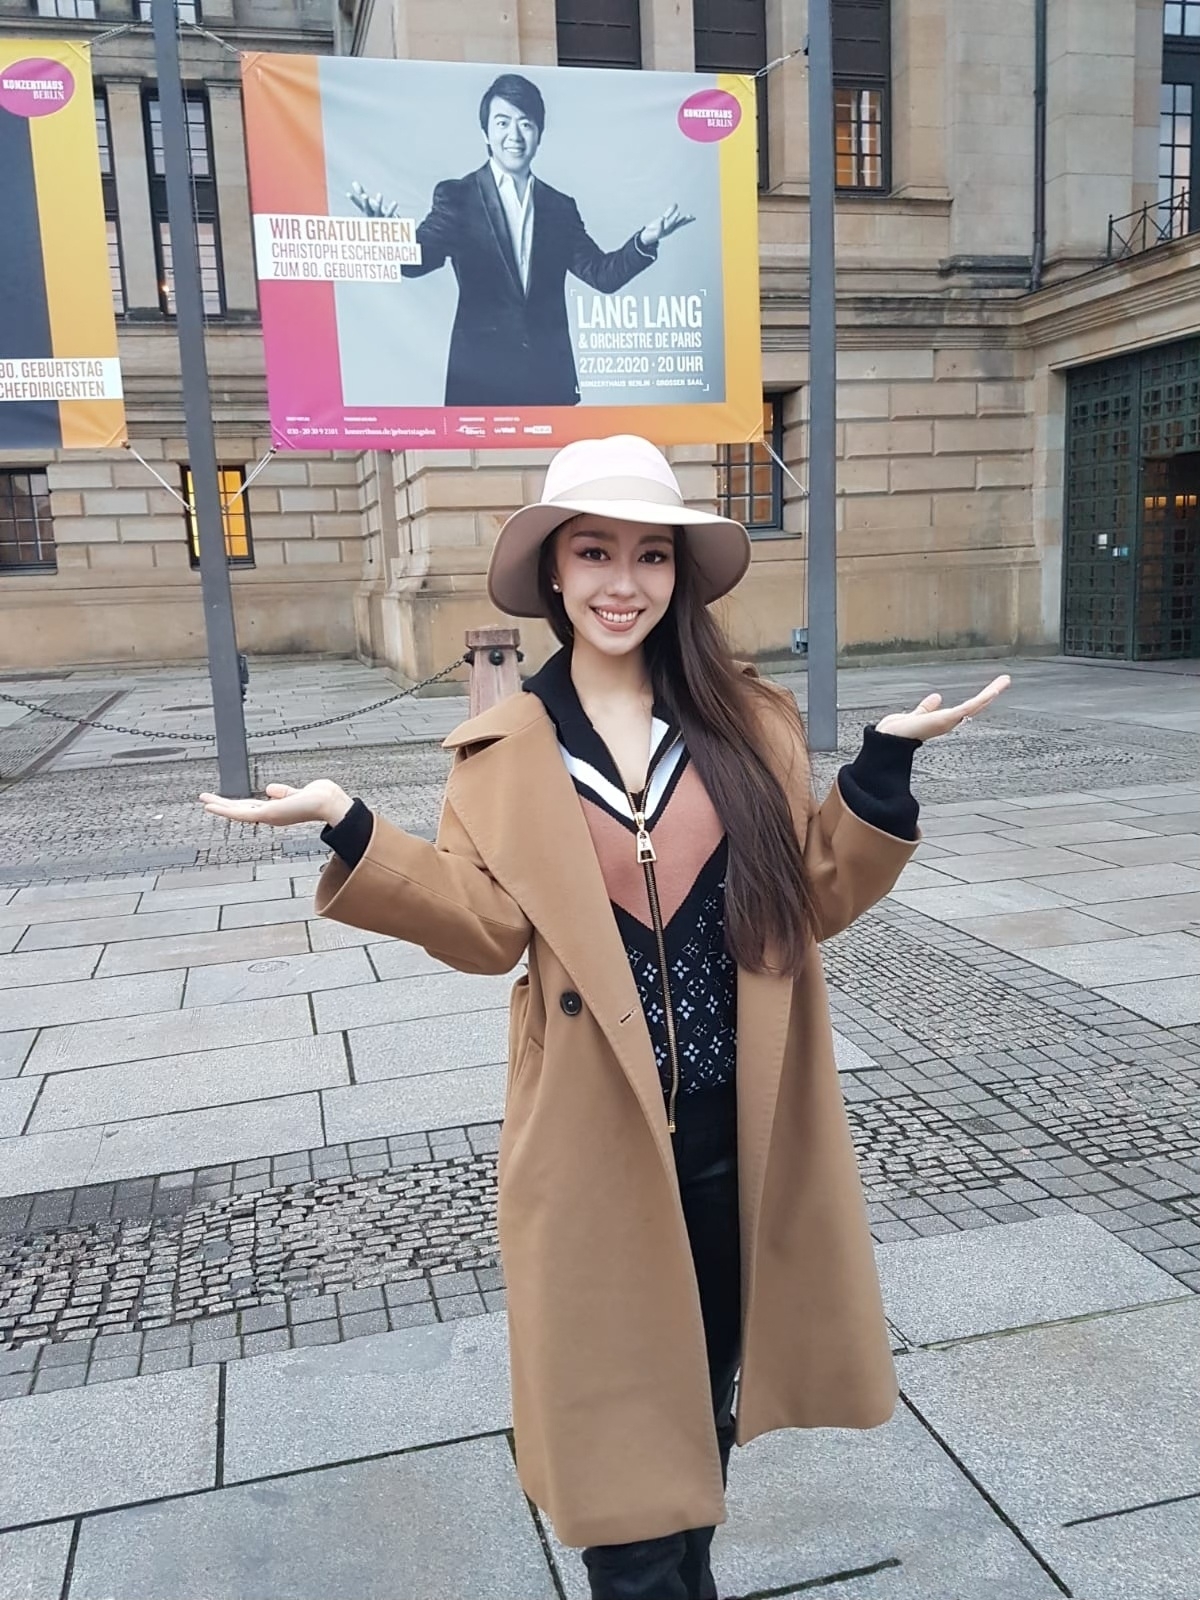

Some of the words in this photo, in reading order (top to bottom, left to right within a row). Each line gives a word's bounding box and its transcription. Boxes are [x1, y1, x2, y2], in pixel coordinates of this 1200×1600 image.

[3, 79, 64, 90] KONZERTHAUS
[33, 90, 65, 100] BERLIN
[683, 108, 733, 119] KONZERTHAUS
[706, 118, 733, 128] BERLIN
[269, 217, 301, 240] WIR
[305, 218, 411, 242] GRATULIEREN
[271, 242, 339, 260] CHRISTOPH
[341, 244, 417, 262] ESCHENBACH
[272, 261, 300, 278] ZUM
[303, 262, 321, 278] 80.
[324, 262, 398, 280] GEBURTSTAG
[577, 294, 639, 329] LANG
[642, 294, 703, 329] LANG
[578, 333, 589, 349] &
[590, 332, 653, 349] ORCHESTRE
[655, 332, 669, 348] DE
[670, 331, 702, 348] PARIS
[21, 360, 103, 378] GEBURTSTAG
[579, 356, 649, 374] 27.02.2020
[657, 355, 674, 373] 20
[676, 355, 704, 373] UHR
